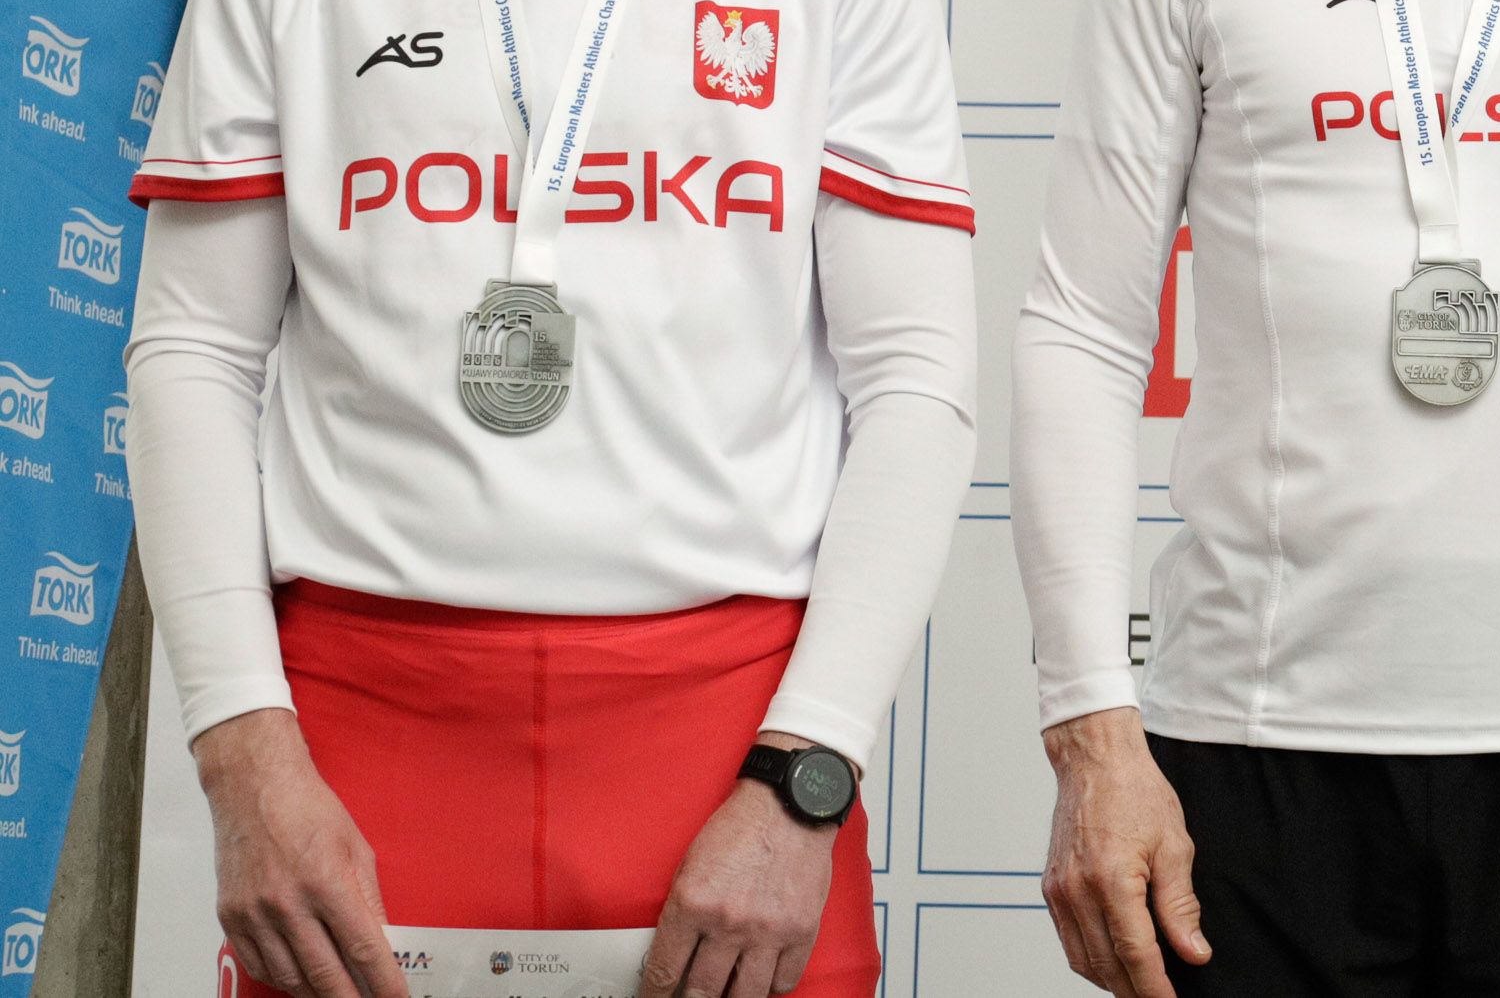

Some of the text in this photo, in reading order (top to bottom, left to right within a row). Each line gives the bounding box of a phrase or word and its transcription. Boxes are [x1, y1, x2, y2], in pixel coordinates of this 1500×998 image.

[499, 5, 516, 53] Athletics
[584, 19, 608, 70] Athletics
[1463, 50, 1486, 93] Masters
[1479, 4, 1500, 50] Athletics
[25, 42, 77, 88] ORK
[511, 55, 523, 101] Masters
[1405, 45, 1421, 90] Masters
[569, 72, 593, 116] Masters
[19, 99, 86, 142] ink ahead.
[1412, 92, 1429, 146] European
[553, 119, 580, 172] European
[1421, 147, 1433, 166] 15.
[339, 151, 783, 232] POLSKA
[548, 173, 563, 192] 15.
[63, 230, 118, 276] TORK
[48, 286, 125, 328] Think ahead.
[0, 388, 44, 430] ORK
[12, 456, 54, 484] ahead.
[95, 473, 125, 499] Think
[37, 576, 89, 616] TORK
[18, 635, 100, 667] Think ahead.
[393, 952, 432, 969] MA
[518, 954, 560, 963] CITY OF
[520, 960, 569, 973] TORUŃ
